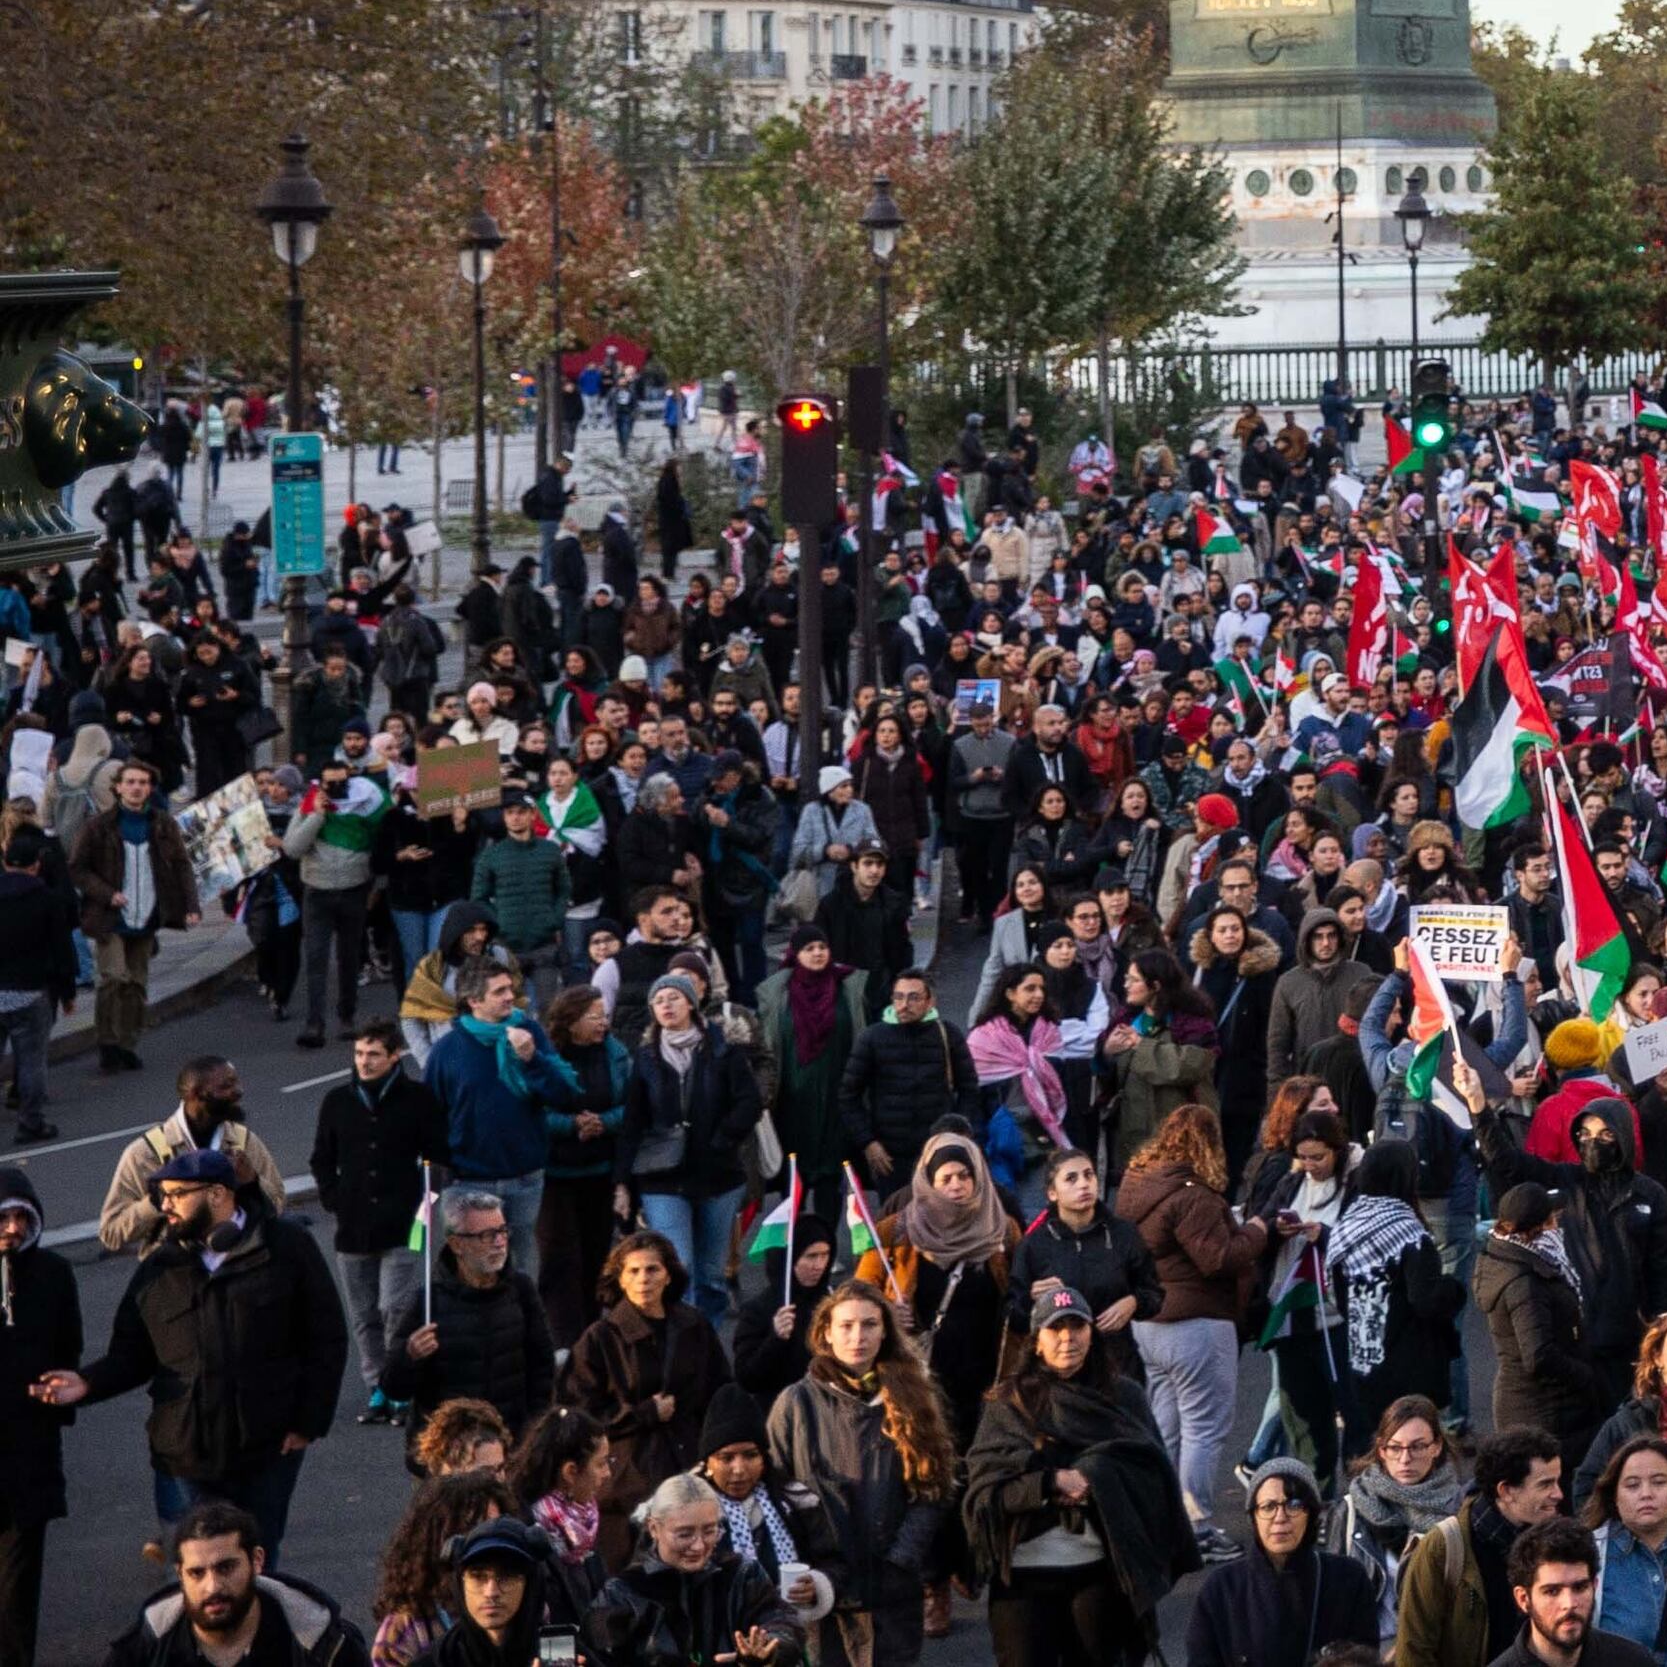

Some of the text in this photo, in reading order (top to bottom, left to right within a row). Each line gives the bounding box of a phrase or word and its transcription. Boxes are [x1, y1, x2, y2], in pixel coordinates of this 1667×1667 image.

[1417, 926, 1498, 945] CESSEZ
[1430, 945, 1441, 962] E
[1449, 946, 1487, 964] FEU
[1636, 1033, 1659, 1049] FREE
